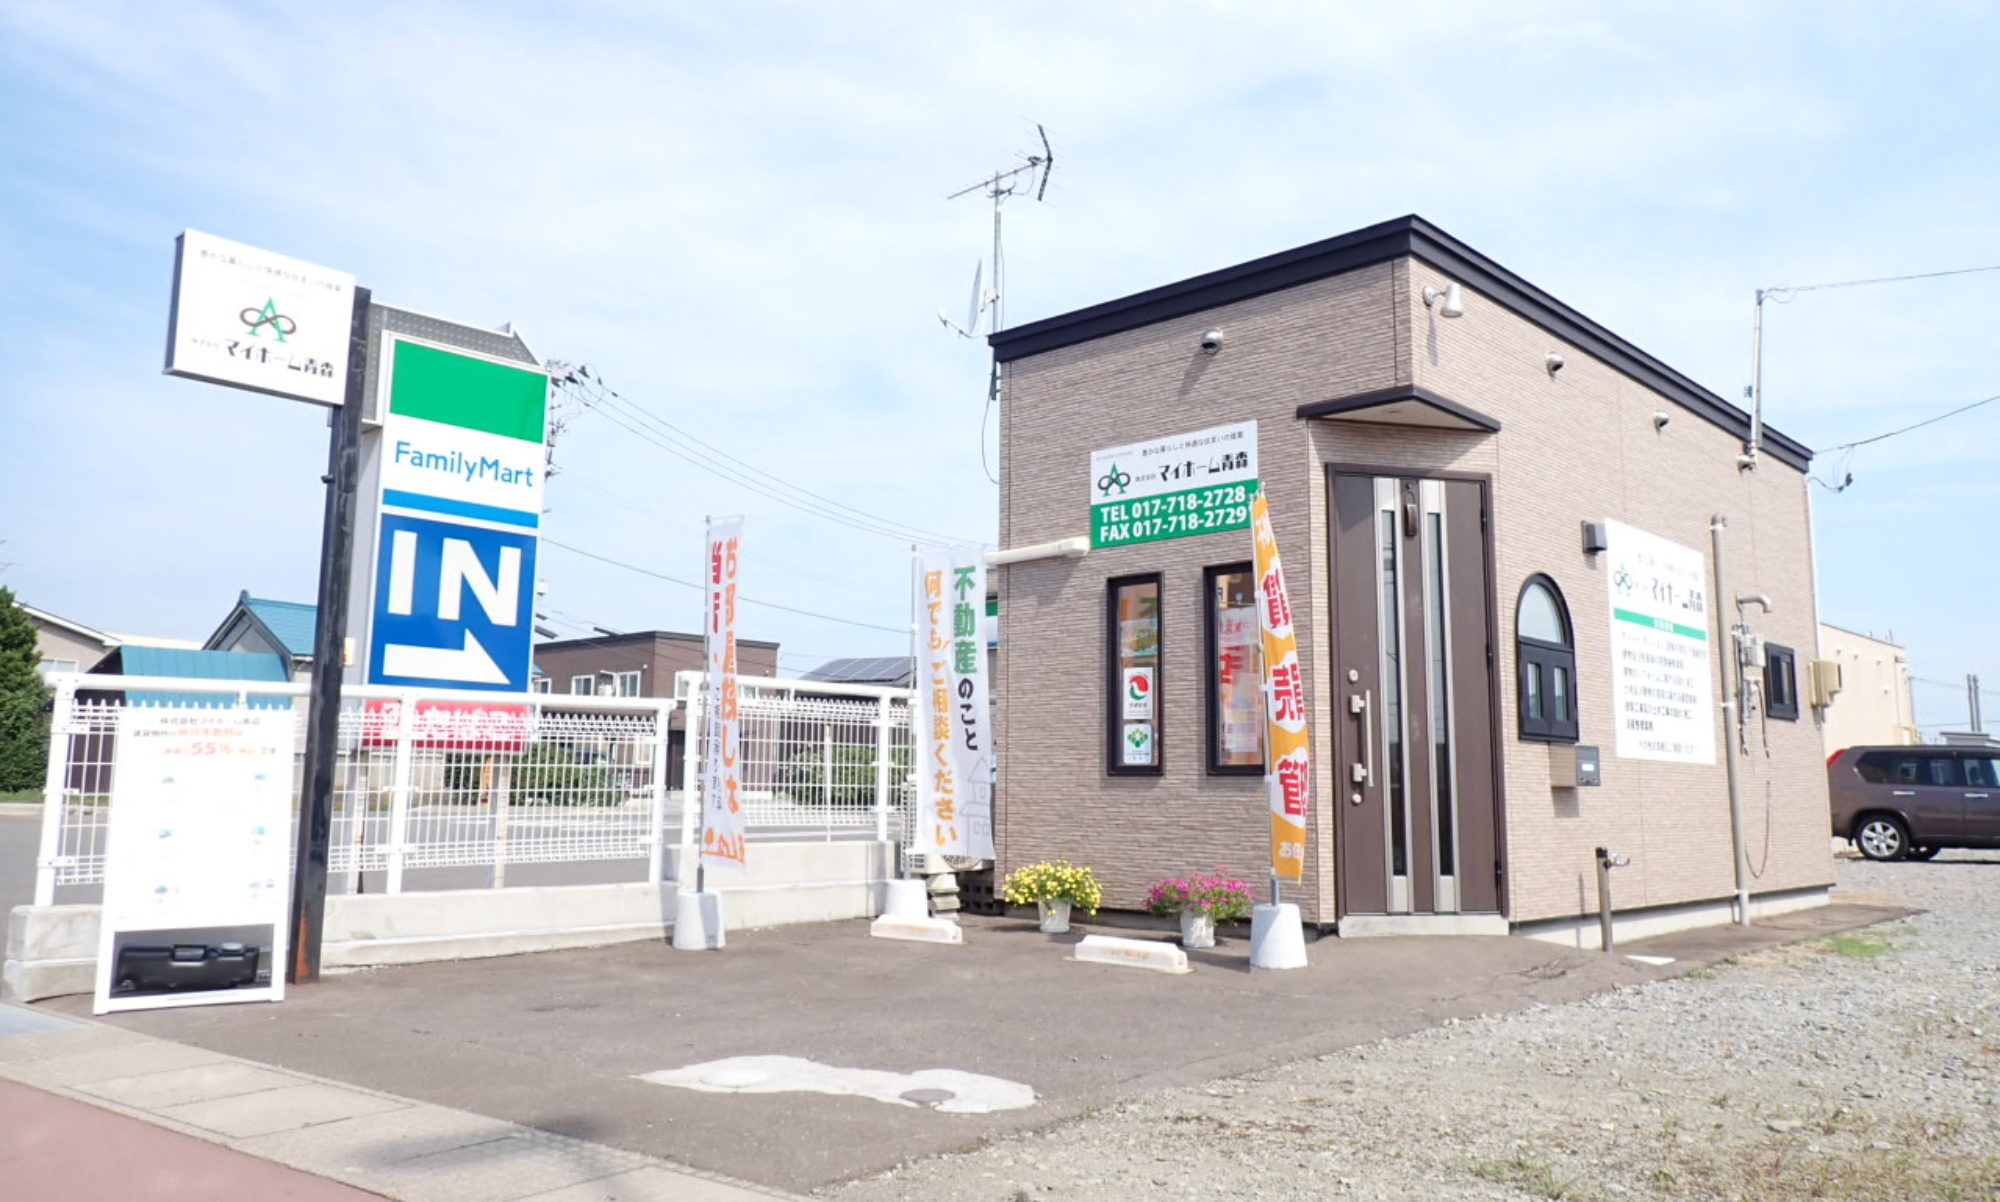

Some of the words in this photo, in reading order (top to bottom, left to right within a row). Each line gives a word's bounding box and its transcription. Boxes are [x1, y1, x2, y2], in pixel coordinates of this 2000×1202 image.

[225, 338, 334, 378] マイホーム青森
[394, 441, 535, 488] FamilyMart
[1158, 451, 1249, 482] マイホーム青森
[1100, 505, 1129, 523] TEL
[1132, 486, 1246, 519] 017-718-2728
[1100, 523, 1130, 543] FAX
[1133, 506, 1247, 538] 017-718-2729
[387, 529, 521, 626] IN
[953, 566, 978, 751] 不動産のこと
